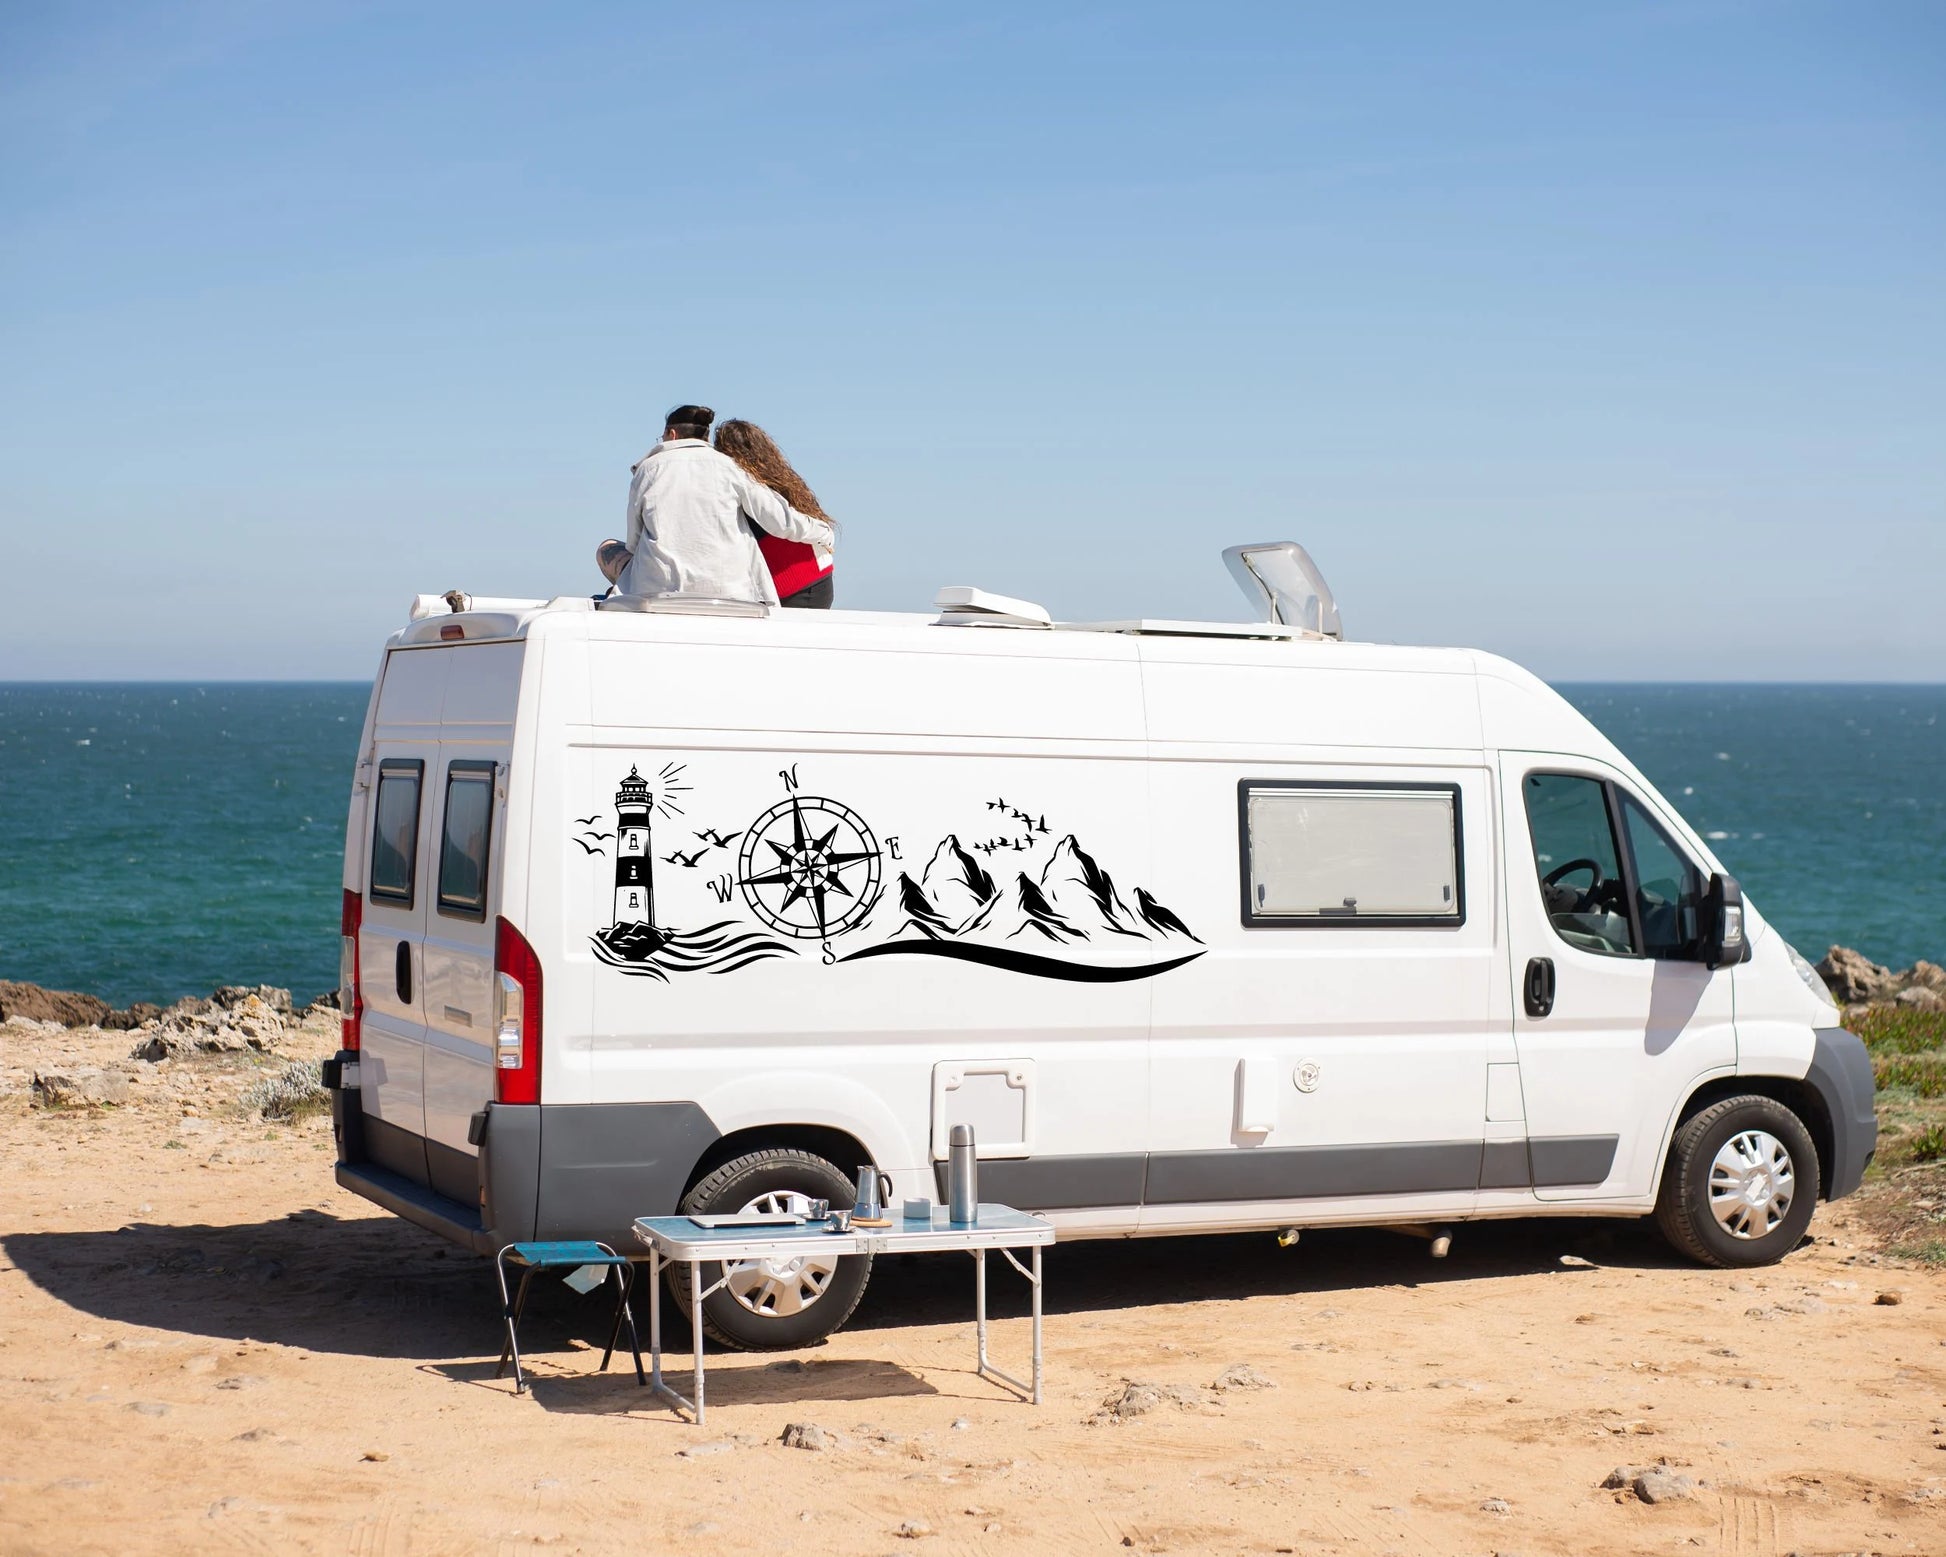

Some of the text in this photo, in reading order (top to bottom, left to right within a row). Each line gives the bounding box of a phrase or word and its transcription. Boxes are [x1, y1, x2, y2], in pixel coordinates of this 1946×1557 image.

[779, 762, 799, 793] N
[884, 836, 903, 860] E
[706, 873, 733, 904] W
[821, 941, 837, 966] S
